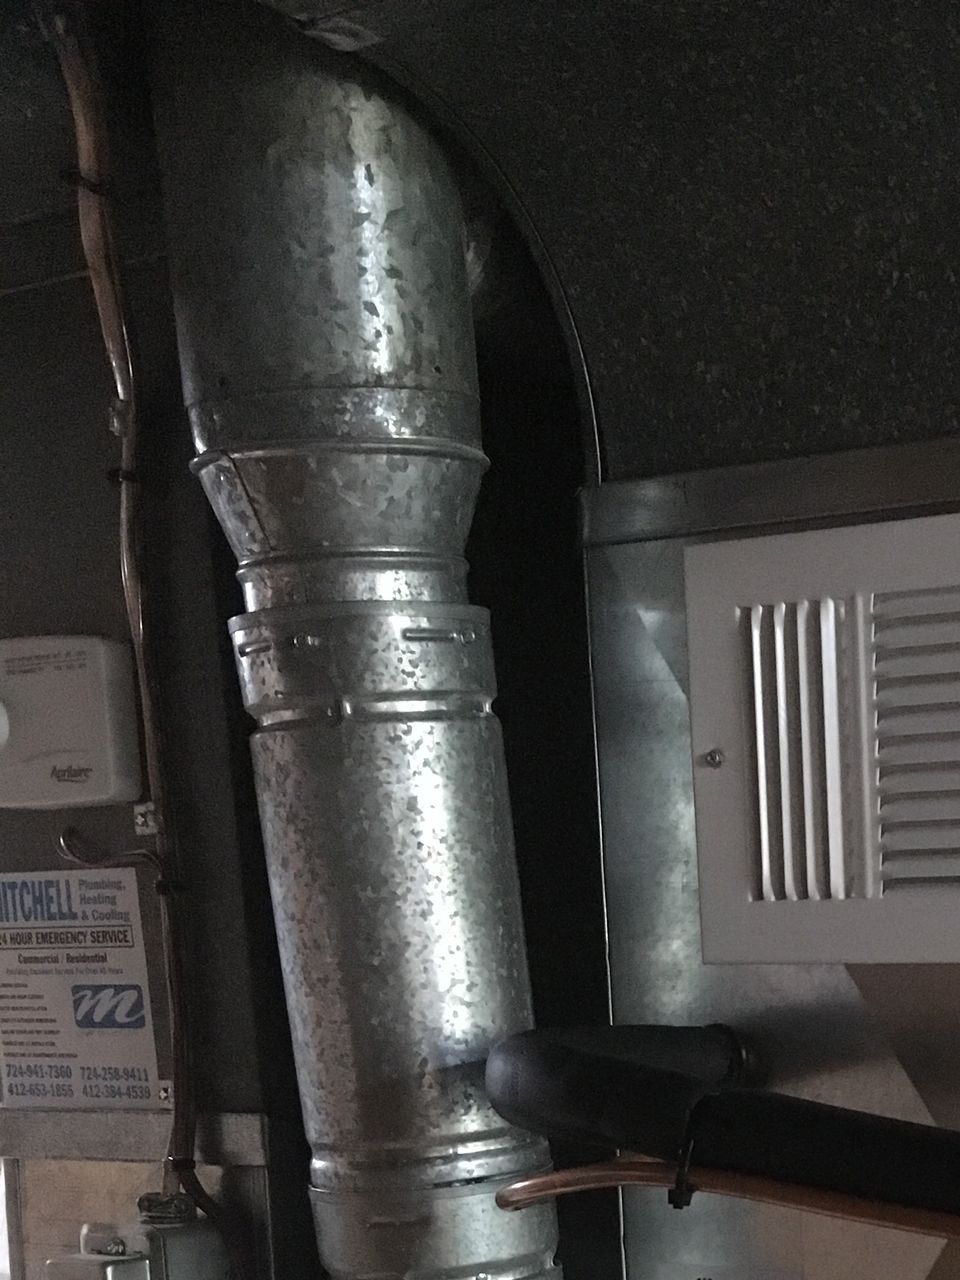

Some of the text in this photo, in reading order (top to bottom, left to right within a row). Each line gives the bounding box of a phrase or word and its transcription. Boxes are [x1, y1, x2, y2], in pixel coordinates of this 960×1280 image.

[79, 879, 126, 891] Plumbing,
[0, 880, 78, 922] ITCHELL
[79, 894, 117, 906] Heating
[81, 909, 130, 923] & Cooling
[10, 932, 33, 945] HOUR
[35, 931, 88, 945] EMERGENCY
[90, 930, 130, 944] SERVICE
[66, 952, 108, 963] Residential
